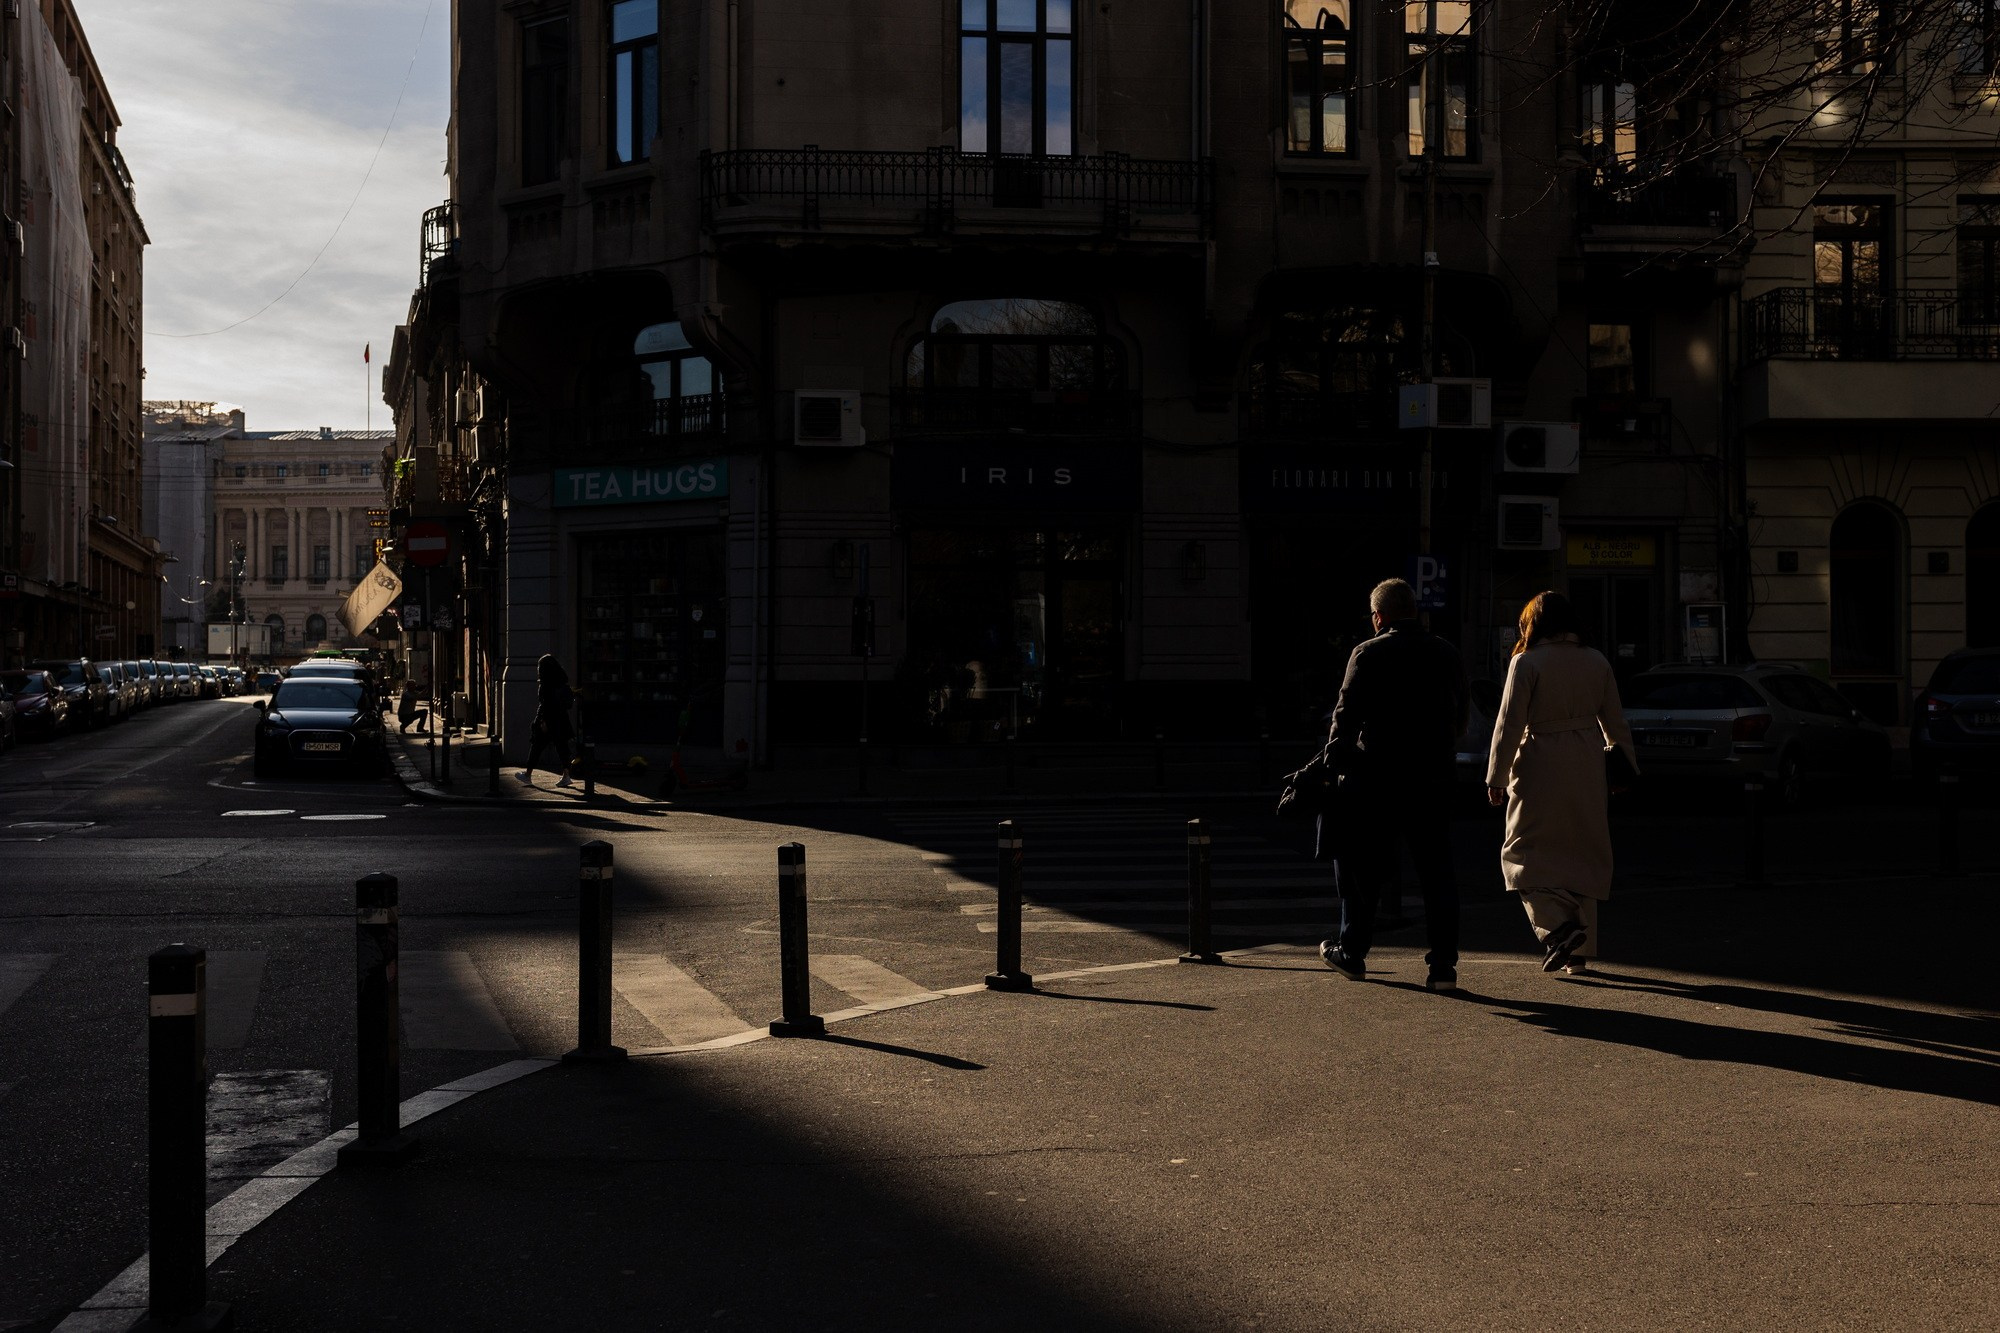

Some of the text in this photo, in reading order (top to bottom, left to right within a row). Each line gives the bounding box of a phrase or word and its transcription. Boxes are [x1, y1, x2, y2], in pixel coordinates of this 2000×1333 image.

[961, 467, 1072, 485] IRIS
[1272, 469, 1349, 489] FLORARI
[1364, 469, 1392, 489] DIN
[569, 472, 623, 501] TEA
[1583, 542, 1601, 550] ALB
[1608, 542, 1640, 551] NEGRU
[1600, 550, 1633, 559] COLOR
[1416, 556, 1438, 601] P
